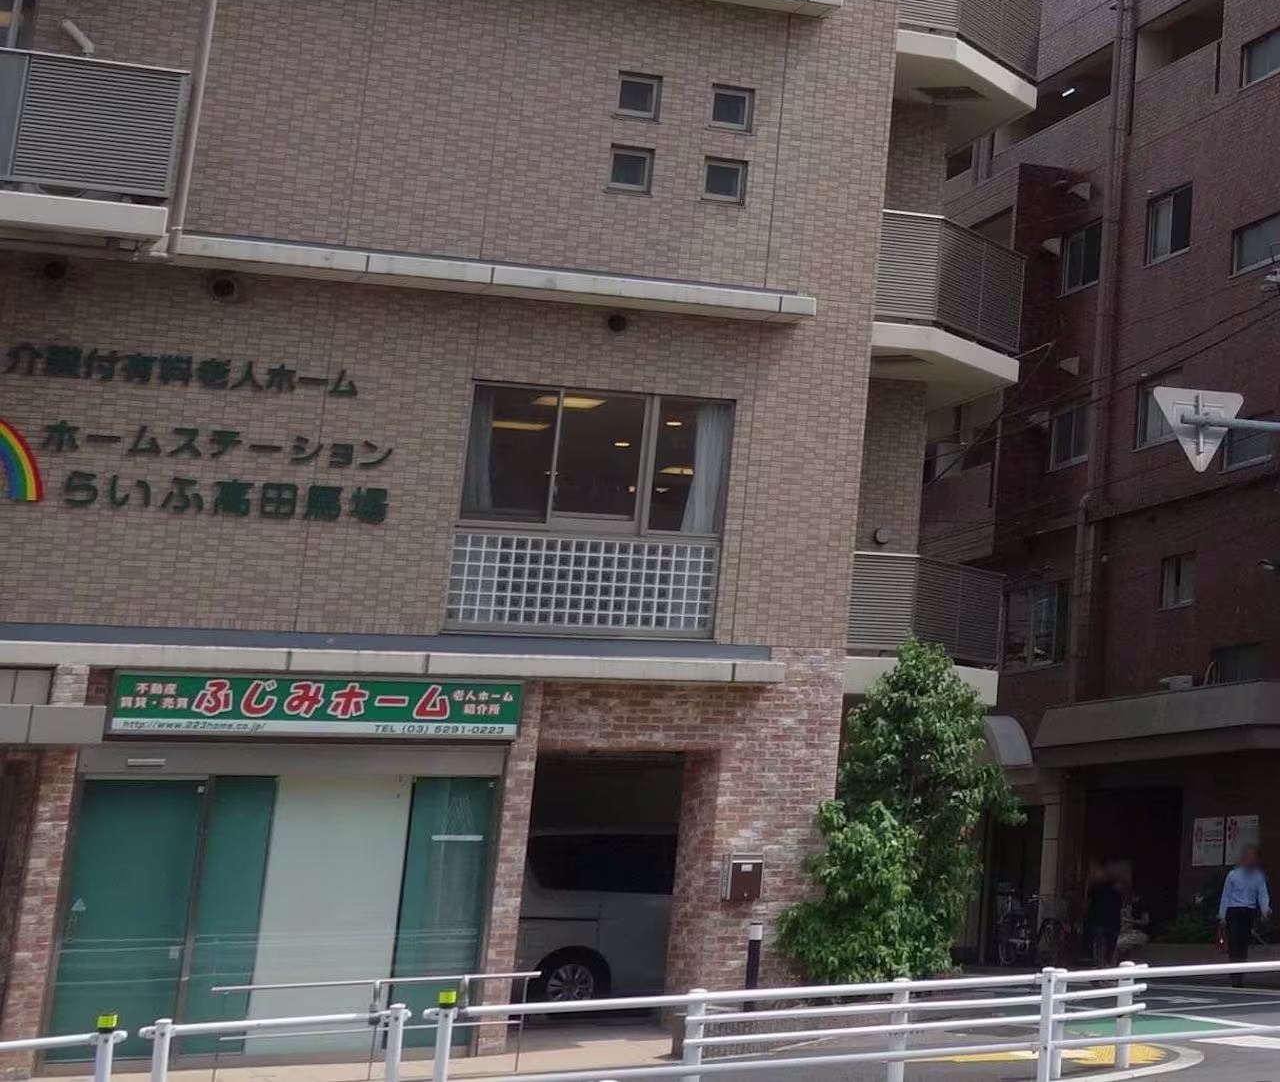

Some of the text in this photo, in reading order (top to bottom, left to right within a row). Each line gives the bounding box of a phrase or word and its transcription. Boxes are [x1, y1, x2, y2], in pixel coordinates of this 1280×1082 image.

[3, 343, 358, 398] 介護付有料老人ホーム
[42, 420, 393, 468] ホームステーション
[63, 470, 389, 524] らいふ高田馬場
[136, 682, 178, 695] 不動産
[192, 679, 450, 719] ふじみホーム
[452, 689, 513, 701] 老人ホーム
[464, 704, 500, 715] 紹介所
[375, 724, 396, 733] TEL
[402, 725, 428, 734] (03)
